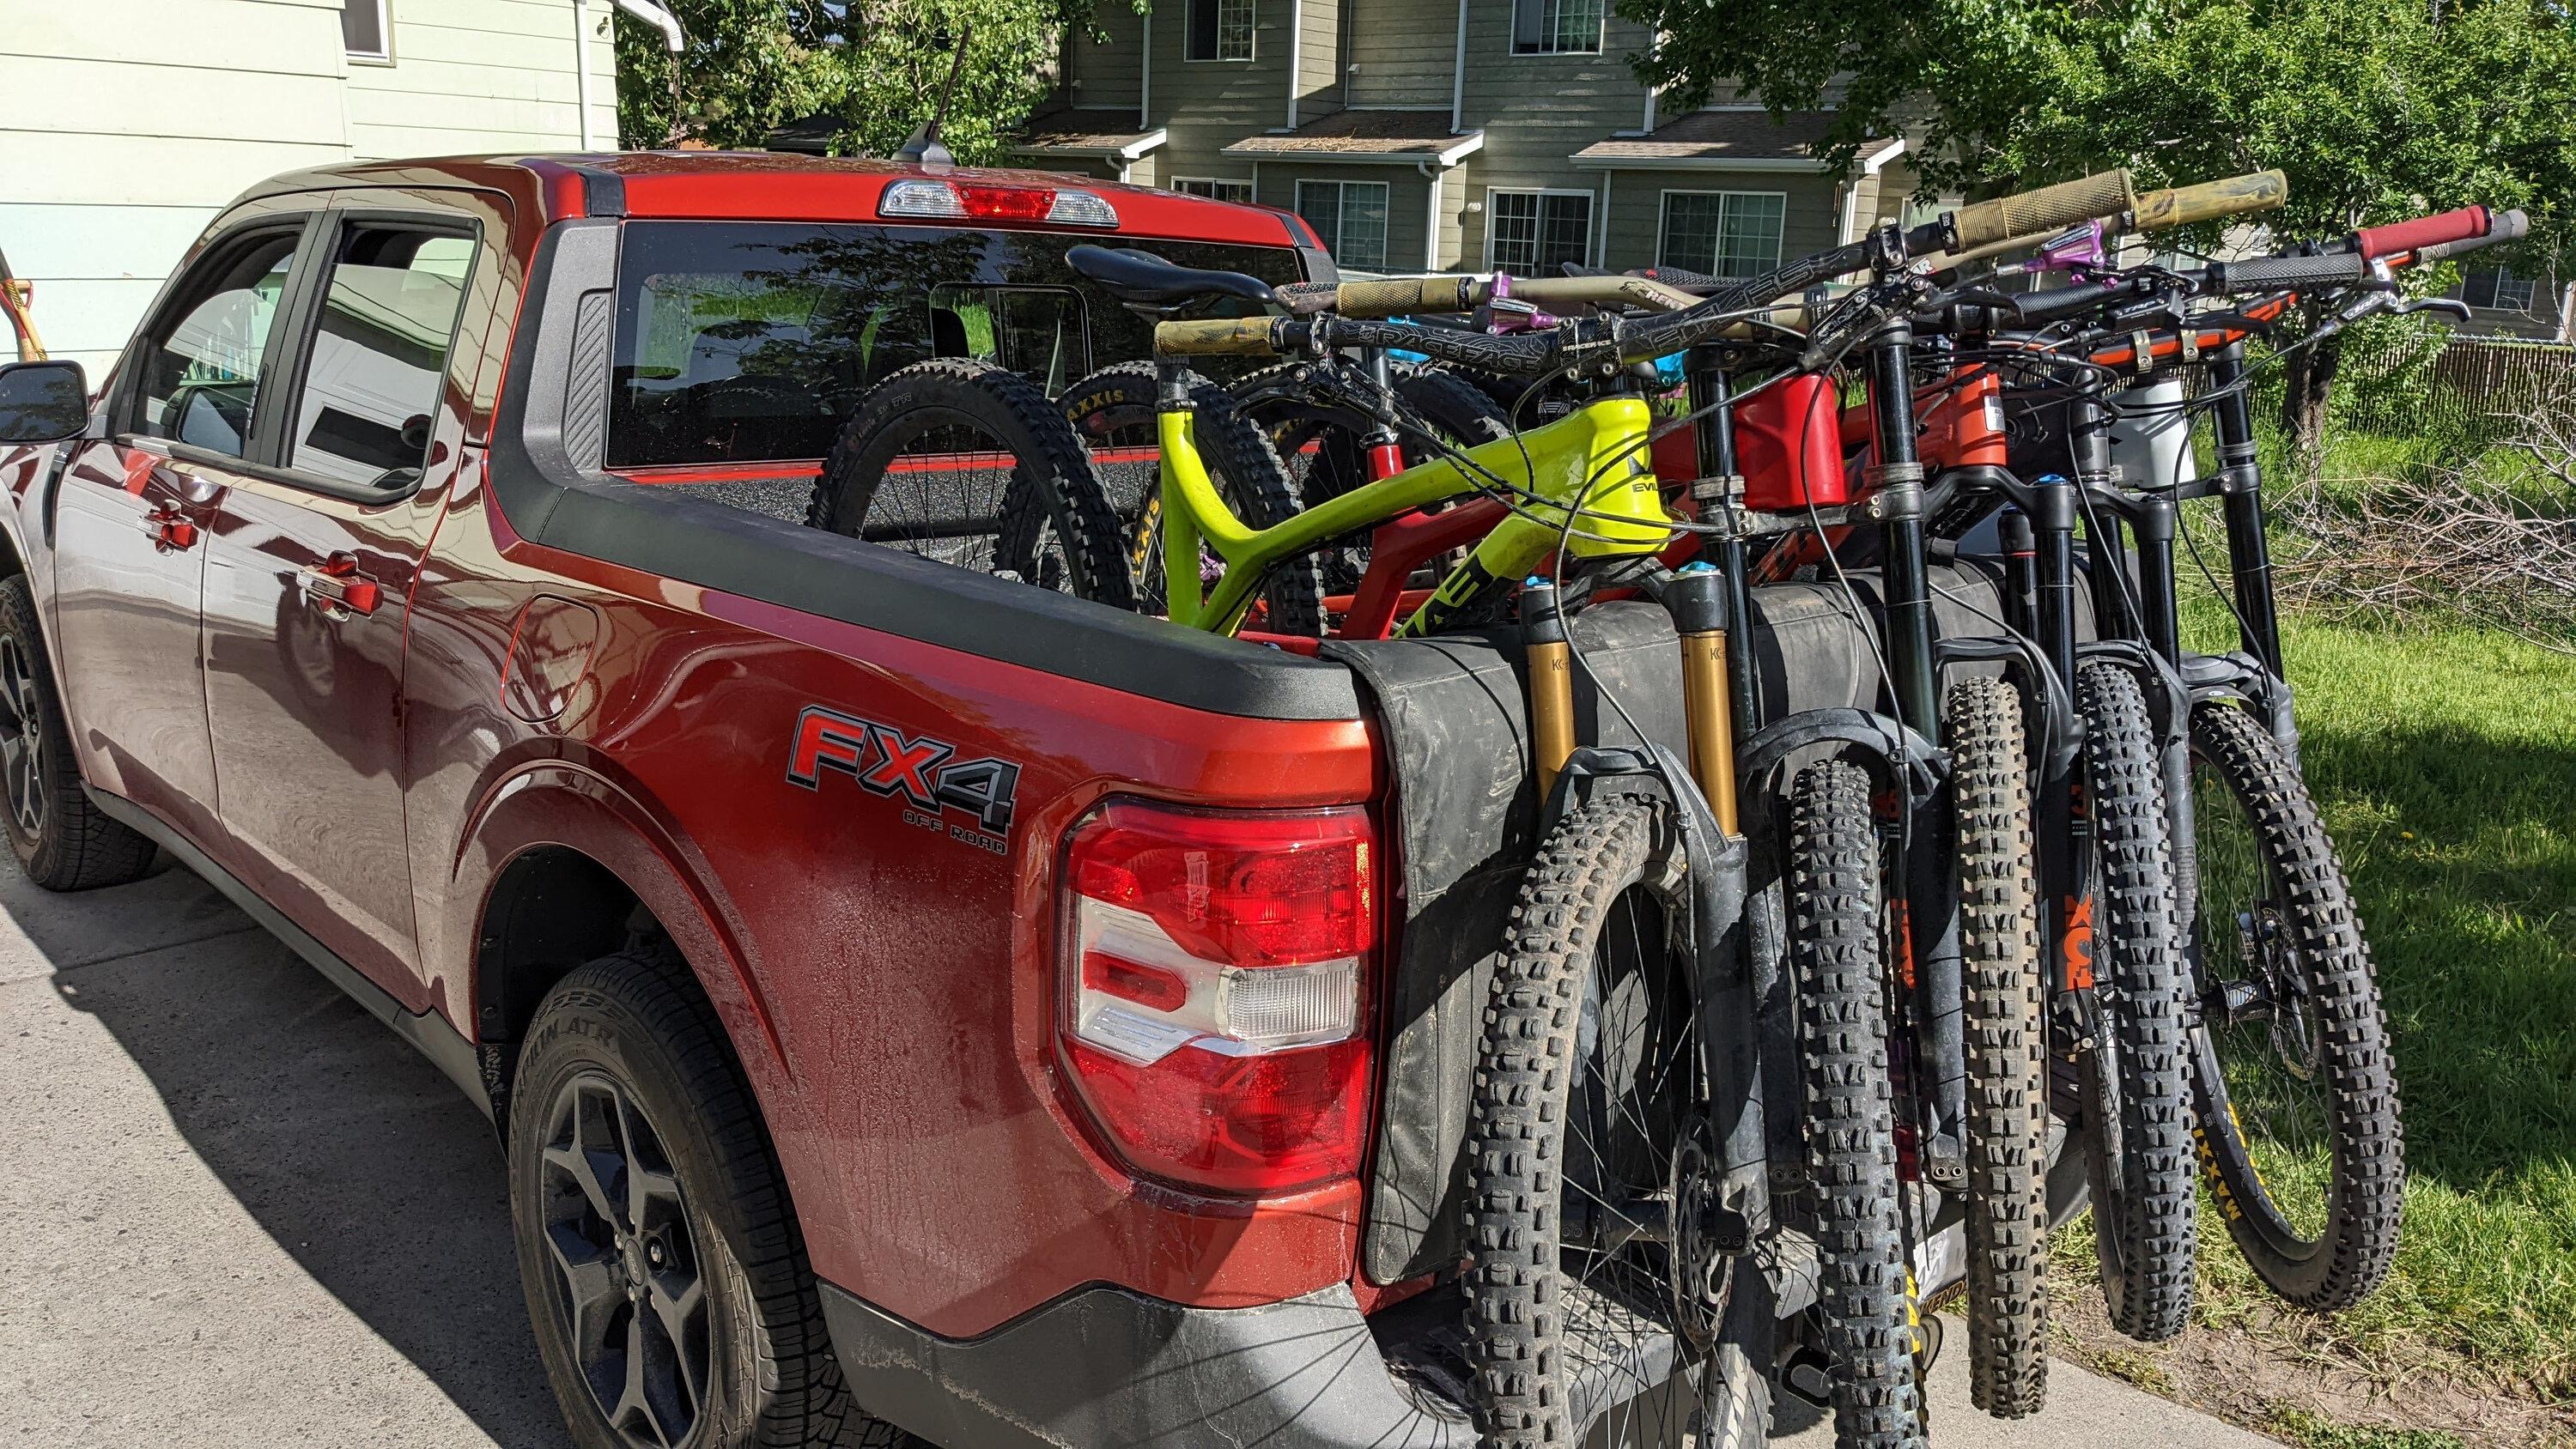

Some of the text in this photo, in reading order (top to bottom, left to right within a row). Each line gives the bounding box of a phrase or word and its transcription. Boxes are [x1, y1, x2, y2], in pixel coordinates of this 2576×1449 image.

[1643, 291, 1686, 313] RENT
[1376, 327, 1541, 373] RACEFACE
[1066, 389, 1124, 421] AXXIS
[1631, 482, 1659, 494] EVIL
[786, 704, 1024, 838] FX4
[902, 809, 1008, 856] OFF ROAD
[2191, 1128, 2242, 1221] MAXXI
